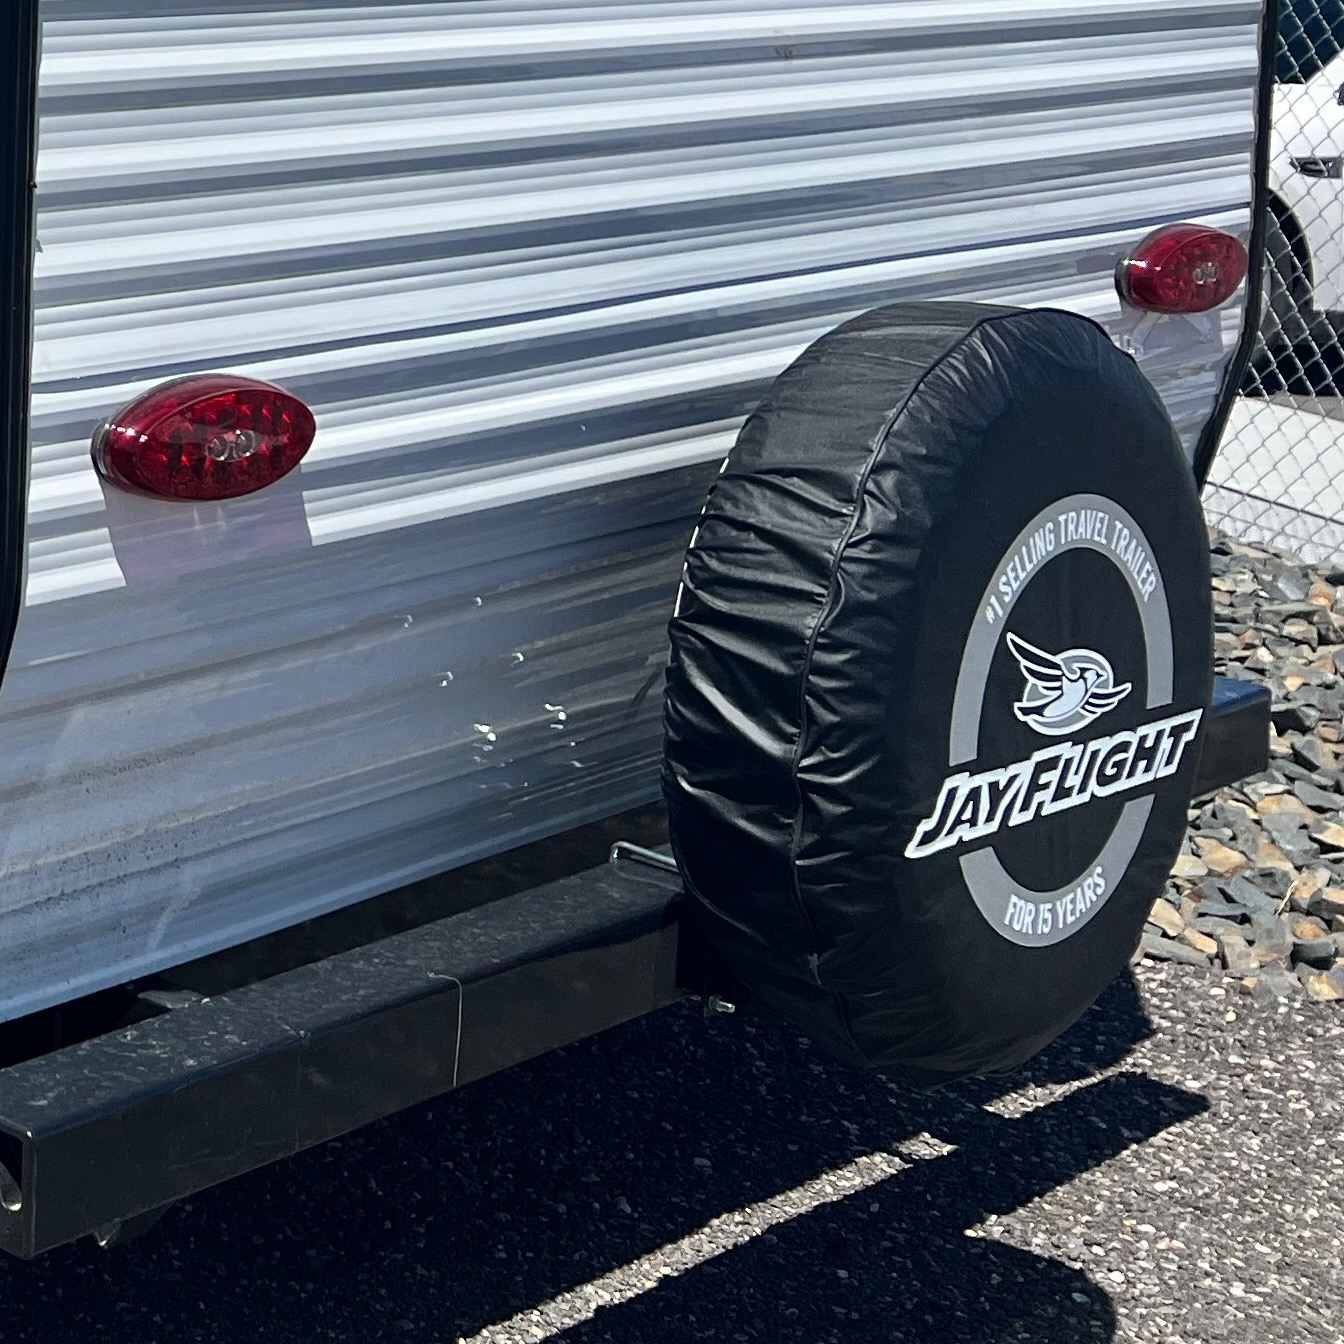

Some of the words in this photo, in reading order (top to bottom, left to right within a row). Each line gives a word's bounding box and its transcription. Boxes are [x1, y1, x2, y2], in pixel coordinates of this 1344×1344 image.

[998, 521, 1055, 603] SELLING
[1058, 509, 1110, 545] TRAVEL
[1111, 520, 1157, 603] TRAILER
[1004, 893, 1036, 934] FOR
[1037, 902, 1053, 934] 15
[1055, 865, 1106, 929] YEARS
